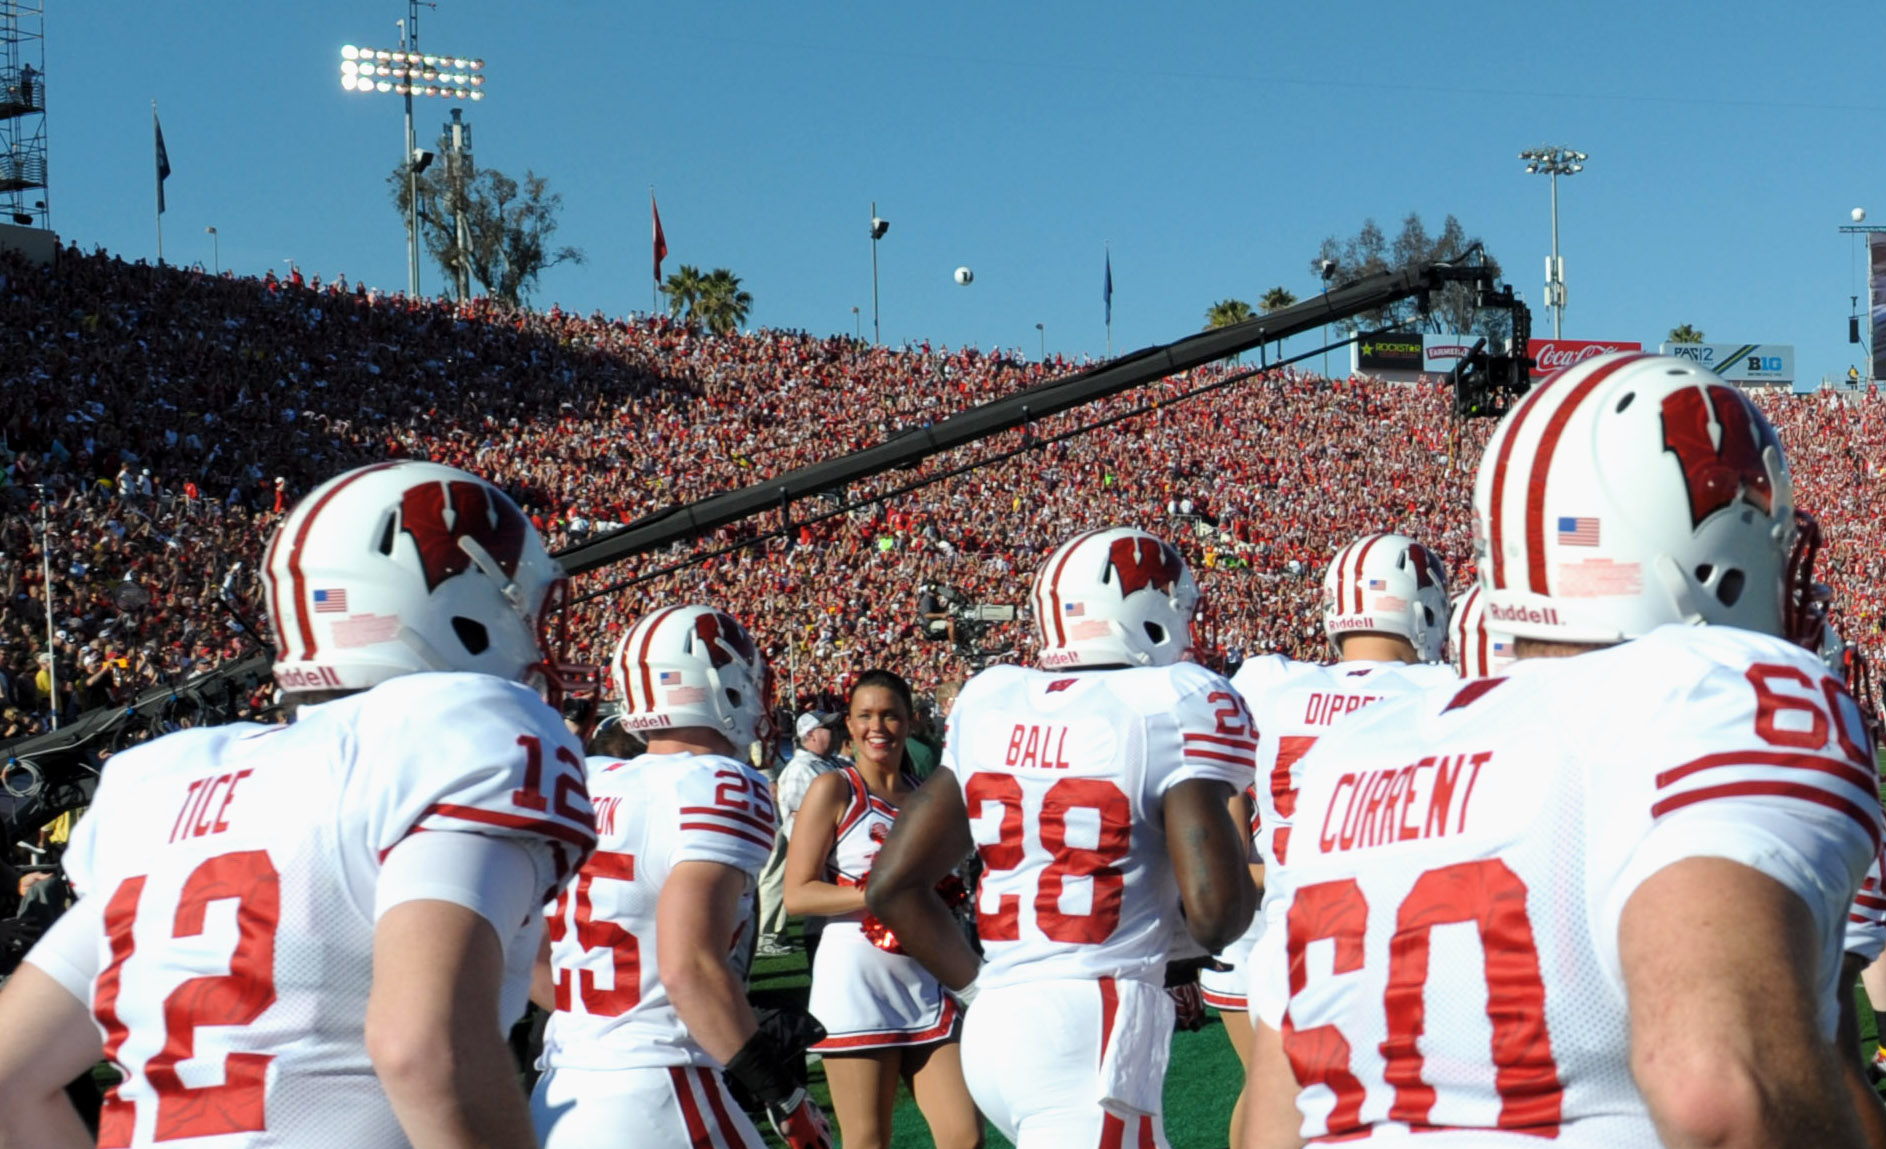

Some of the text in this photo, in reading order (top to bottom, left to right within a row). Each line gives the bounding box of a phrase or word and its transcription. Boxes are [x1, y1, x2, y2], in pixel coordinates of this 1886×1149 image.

[1329, 618, 1375, 631] Riddell
[1490, 603, 1559, 626] Riddell
[1005, 724, 1070, 770] BALL
[1304, 693, 1384, 726] DIPP
[1744, 662, 1877, 776] 60
[169, 767, 255, 844] TICE
[511, 734, 594, 829] 12
[714, 770, 775, 825] 25
[1319, 751, 1493, 854] CURRENT
[966, 772, 1131, 945] 28
[1282, 857, 1564, 1144] 60
